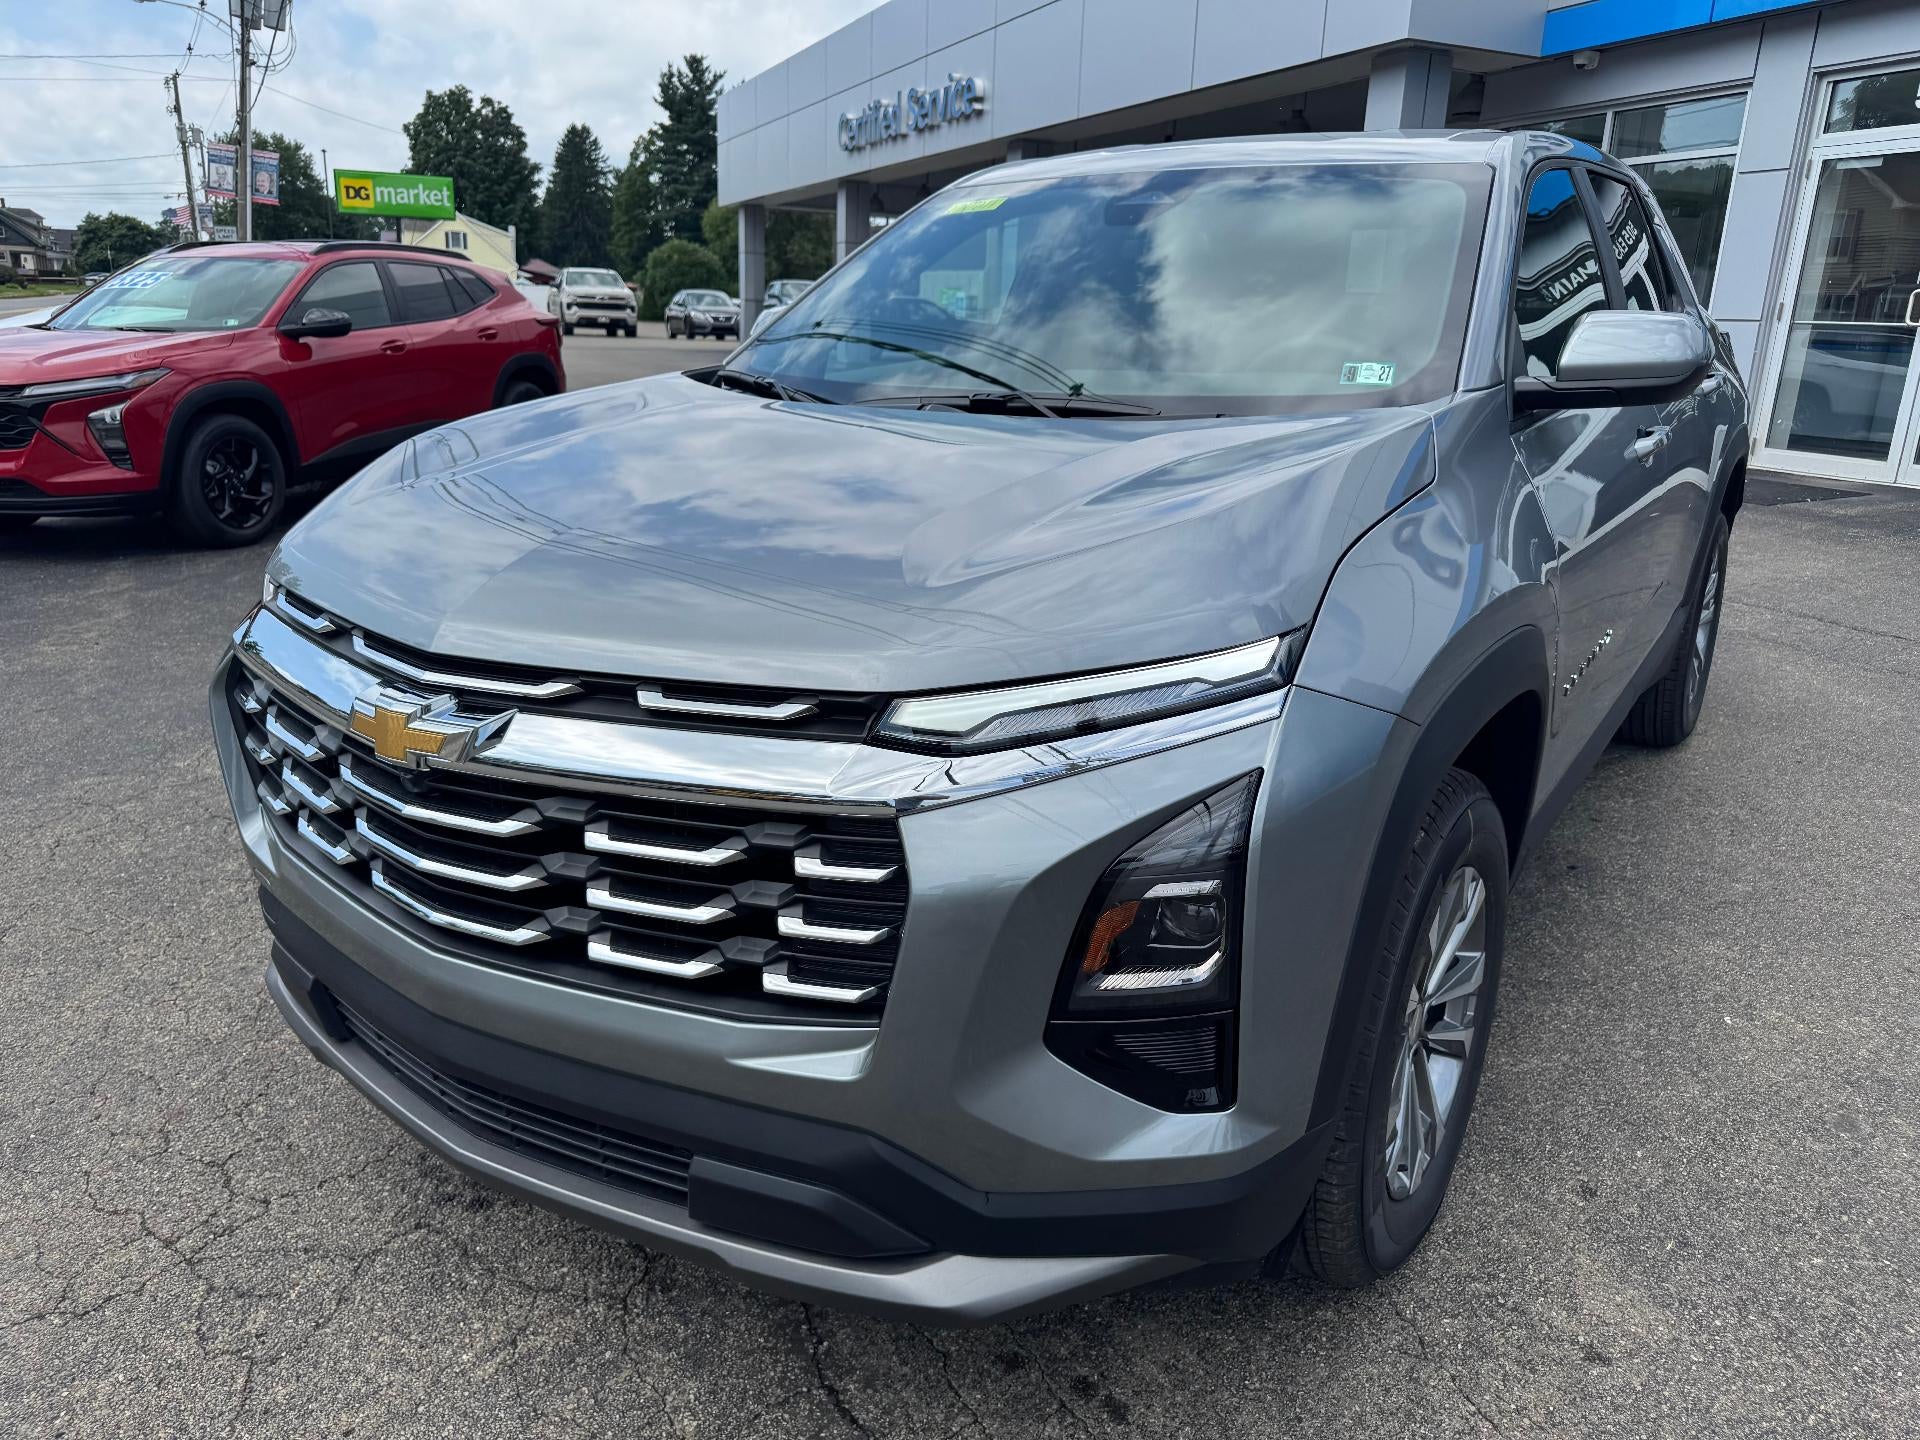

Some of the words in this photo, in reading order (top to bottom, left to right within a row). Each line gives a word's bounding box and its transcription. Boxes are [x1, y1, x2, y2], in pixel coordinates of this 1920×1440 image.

[838, 90, 905, 152] Certified
[908, 72, 984, 132] Service
[343, 184, 371, 201] DG
[374, 183, 452, 207] market
[1377, 365, 1392, 383] 27
